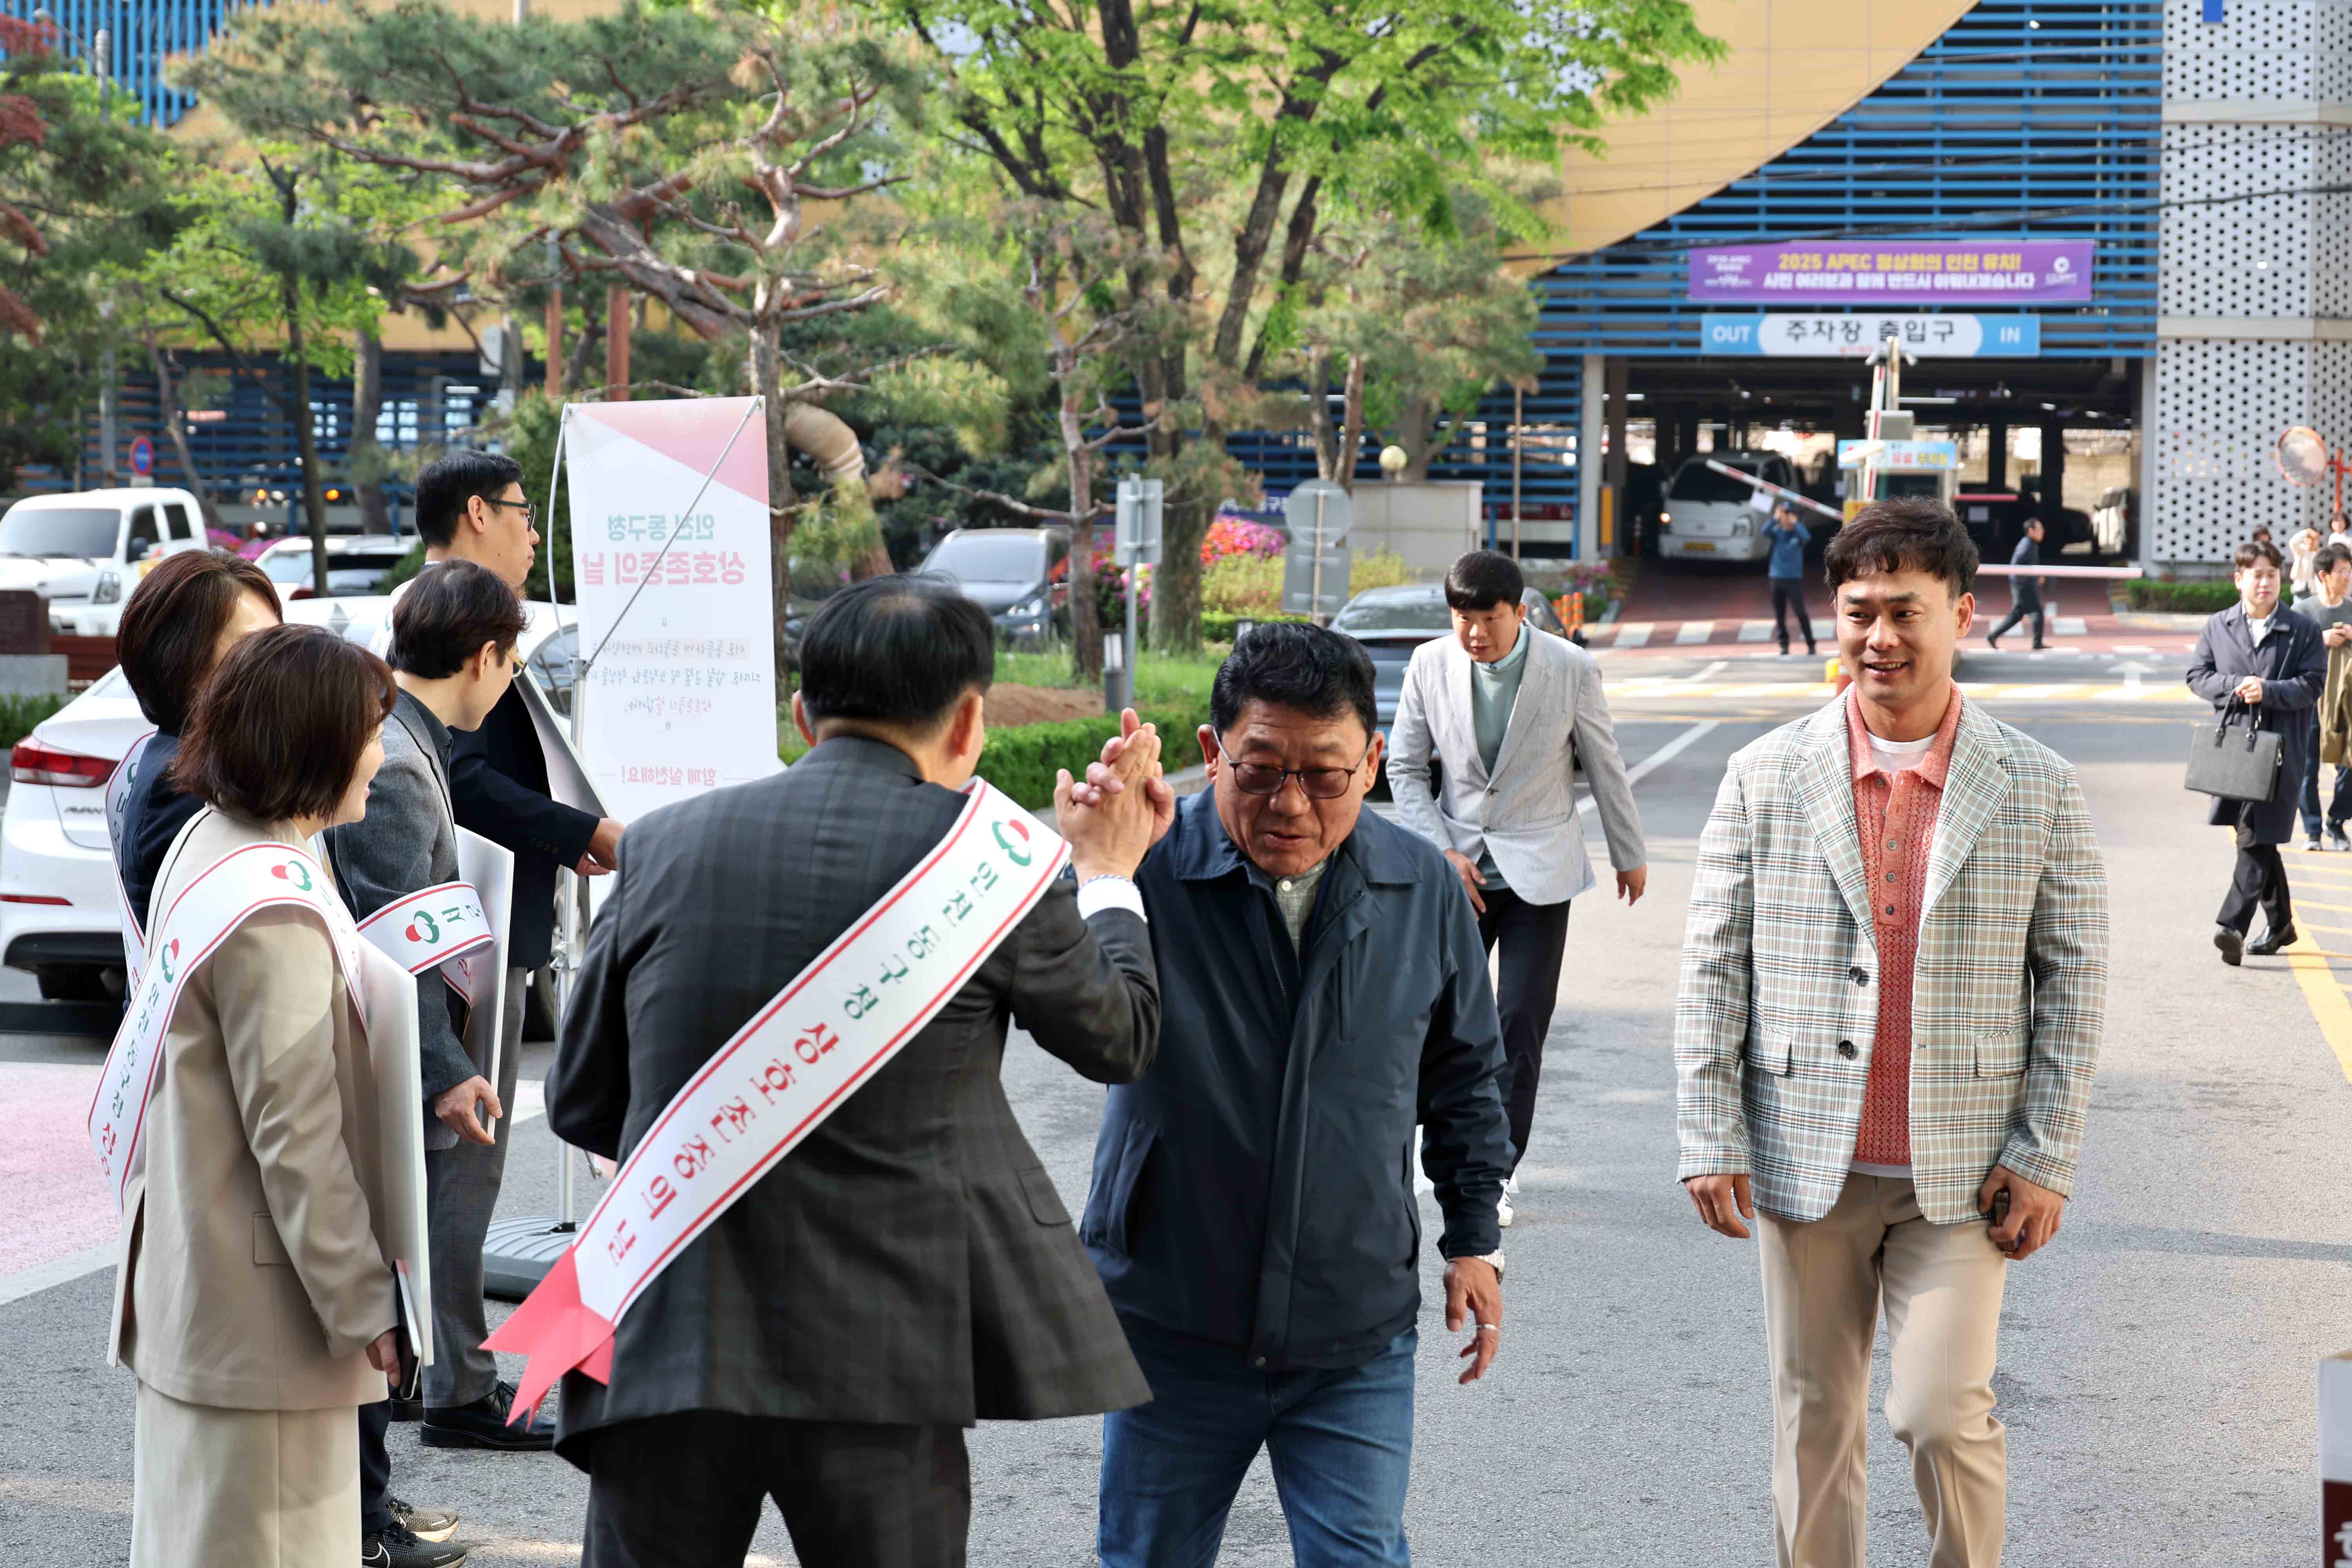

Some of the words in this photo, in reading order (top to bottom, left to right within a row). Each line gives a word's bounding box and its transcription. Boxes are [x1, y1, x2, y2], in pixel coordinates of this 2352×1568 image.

[1779, 253, 1822, 270] 2025
[1827, 253, 1872, 271] APEC
[1877, 253, 1942, 271] 정상회의
[1945, 253, 1979, 270] 인천
[1983, 253, 2021, 270] 유치!
[1764, 272, 1794, 289] 시민
[1795, 272, 1853, 289] 여러분과
[1887, 272, 1931, 289] 반드시
[1712, 325, 1751, 343] OUT
[1786, 319, 1862, 343] 주차장
[1878, 319, 1955, 343] 출입구
[2000, 326, 2021, 344] IN
